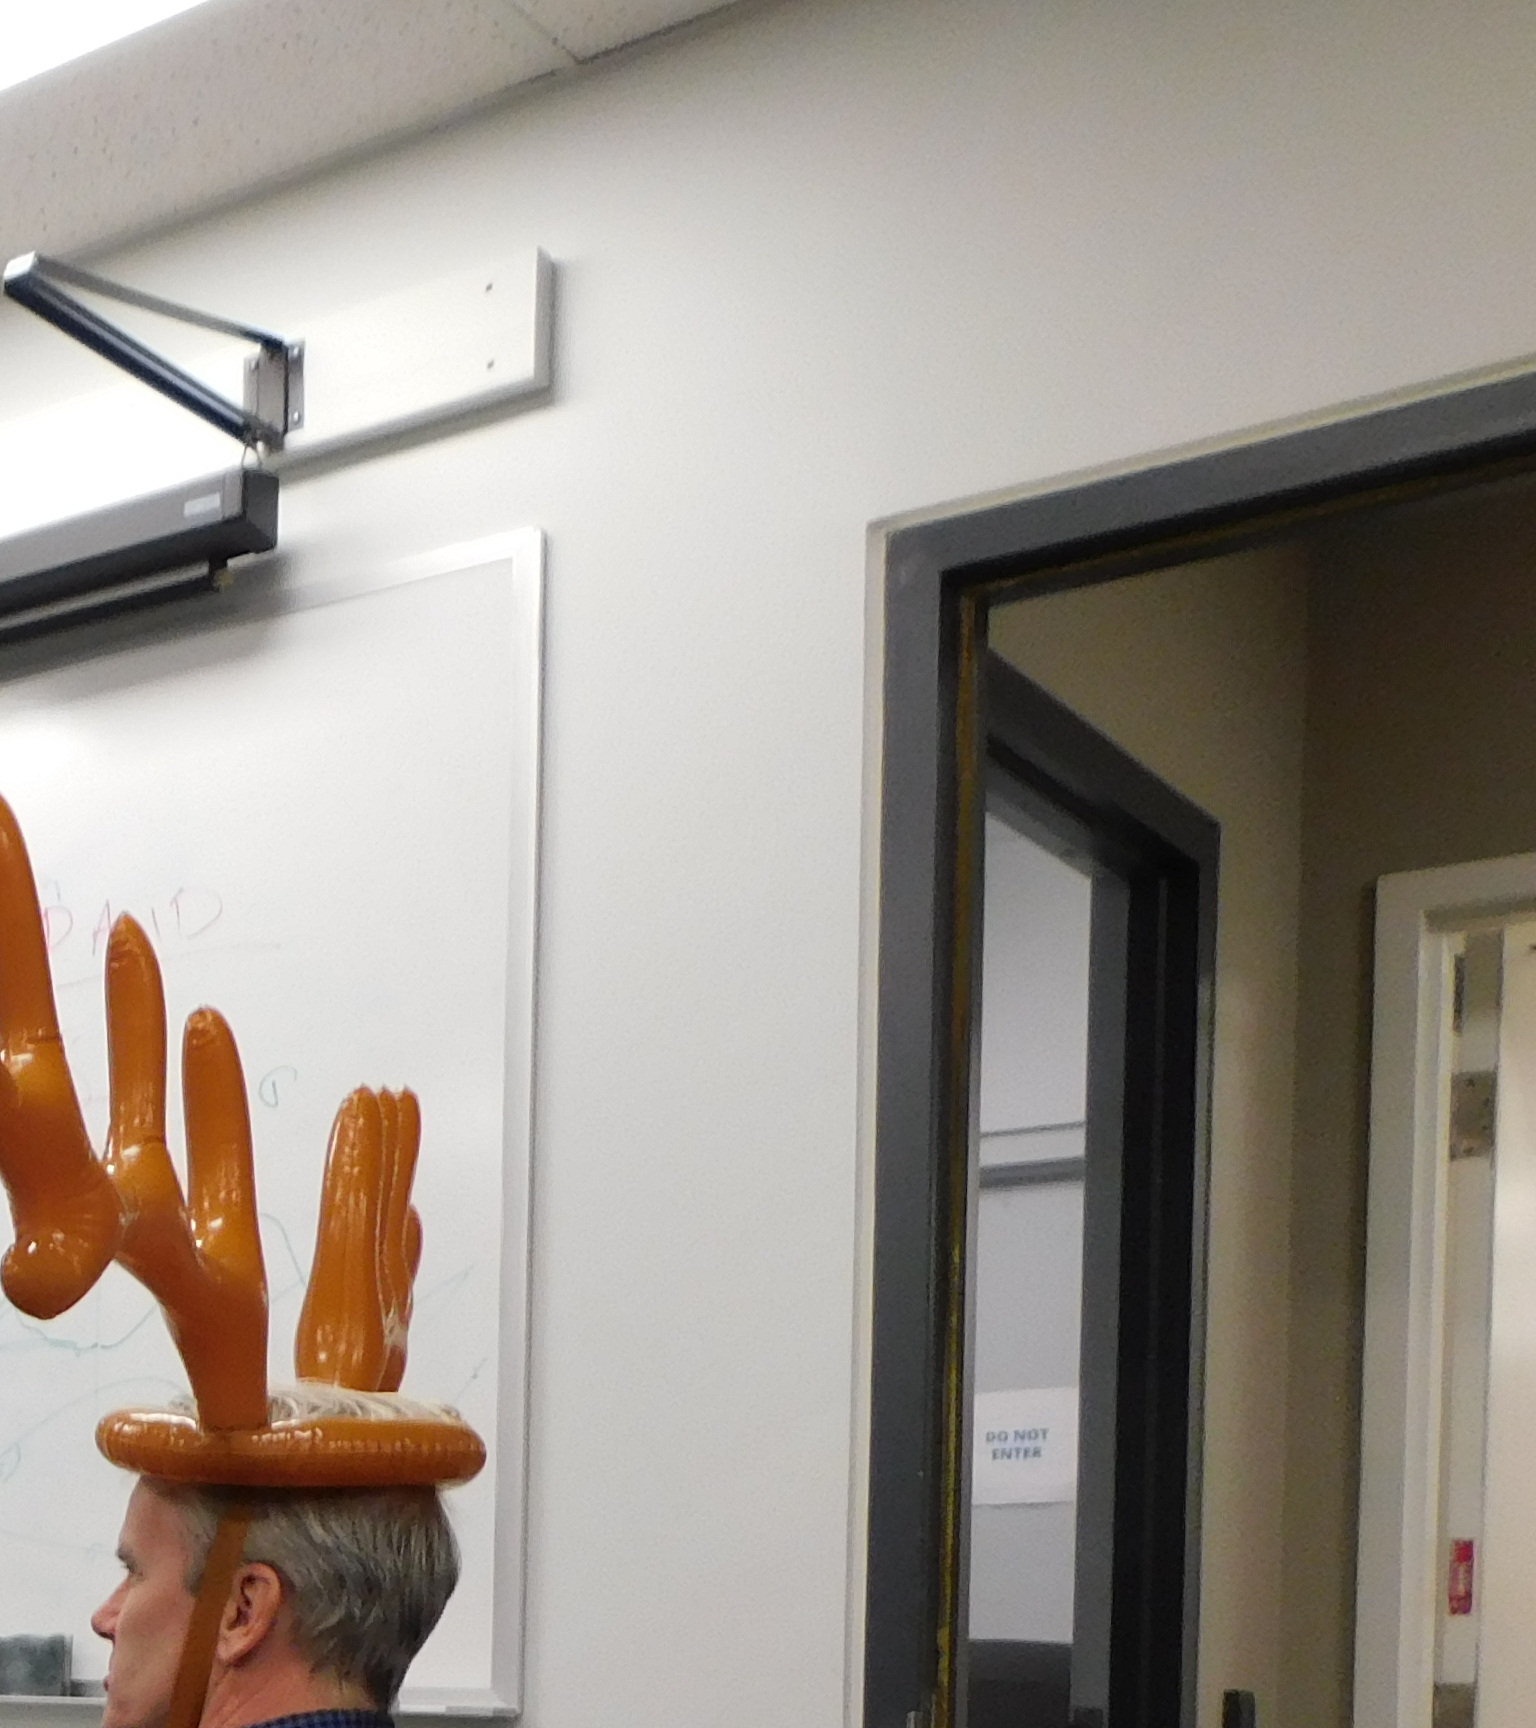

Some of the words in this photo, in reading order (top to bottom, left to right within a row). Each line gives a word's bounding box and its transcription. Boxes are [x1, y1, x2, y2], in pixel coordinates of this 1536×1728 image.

[985, 1429, 1009, 1444] DO
[1013, 1427, 1049, 1443] NOT
[991, 1446, 1042, 1462] ENTER
